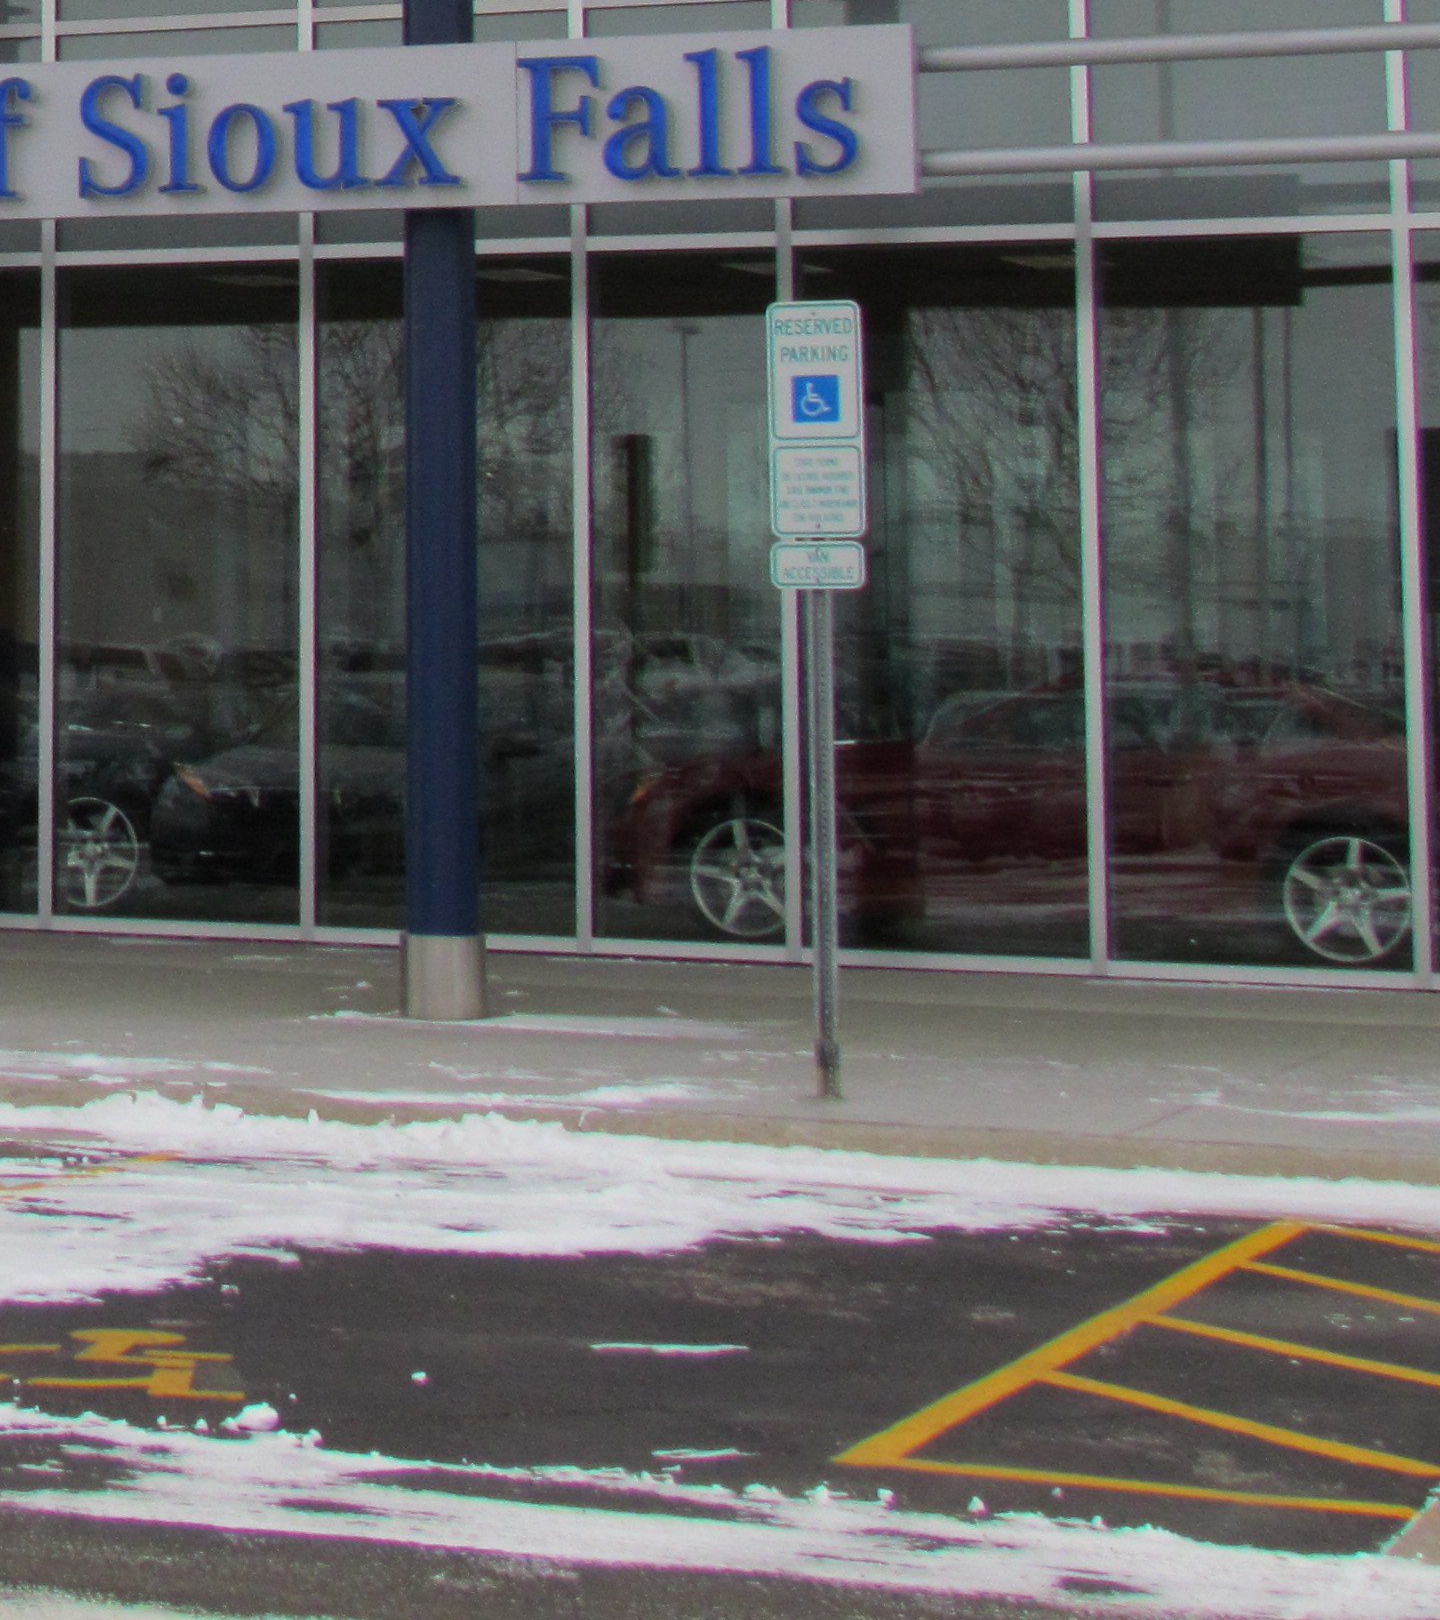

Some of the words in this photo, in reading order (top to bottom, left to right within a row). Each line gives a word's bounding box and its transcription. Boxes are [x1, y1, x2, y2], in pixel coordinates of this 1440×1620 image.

[77, 72, 463, 199] Sioux
[516, 45, 862, 182] Falls
[774, 317, 852, 336] RESERVED
[780, 345, 849, 363] PARKING
[807, 550, 830, 563] VAN
